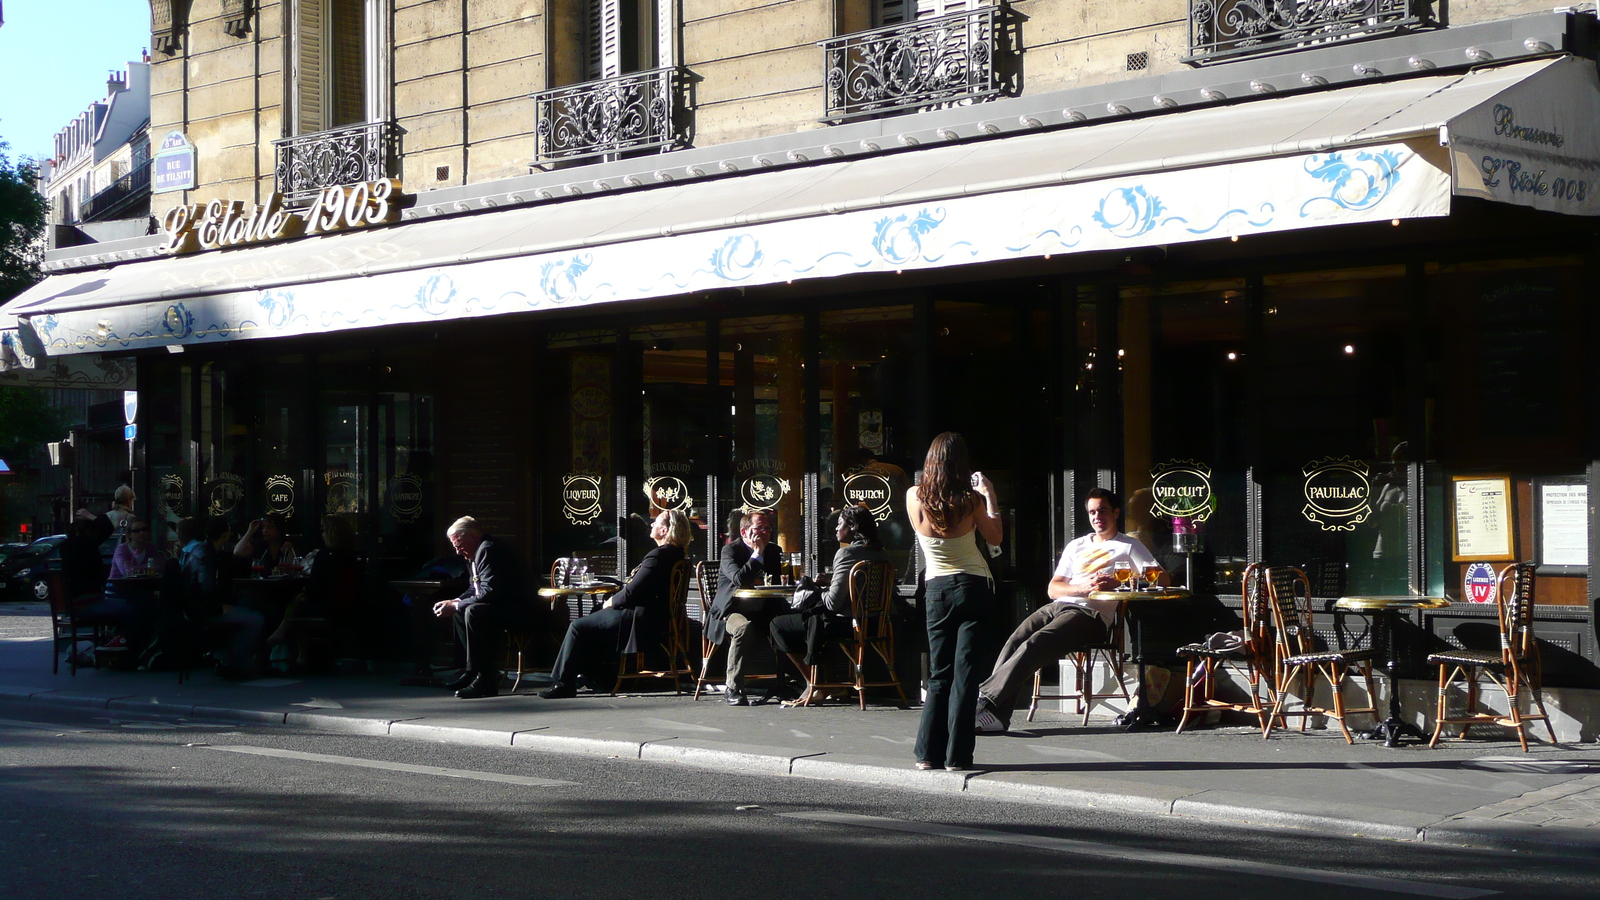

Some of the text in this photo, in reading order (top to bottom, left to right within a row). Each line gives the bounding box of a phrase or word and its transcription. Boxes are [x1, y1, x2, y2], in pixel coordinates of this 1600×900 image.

[1493, 103, 1564, 148] Brasserie
[166, 160, 181, 170] RUE
[157, 170, 191, 183] DE TILSITT
[1482, 156, 1587, 202] L'Etoile 1903
[158, 177, 393, 254] L'Etoile 1903
[849, 489, 885, 500] BRUNCH
[1156, 485, 1206, 498] VIN CUIT
[1309, 486, 1364, 499] PAUILLAC
[1475, 586, 1487, 597] IV
